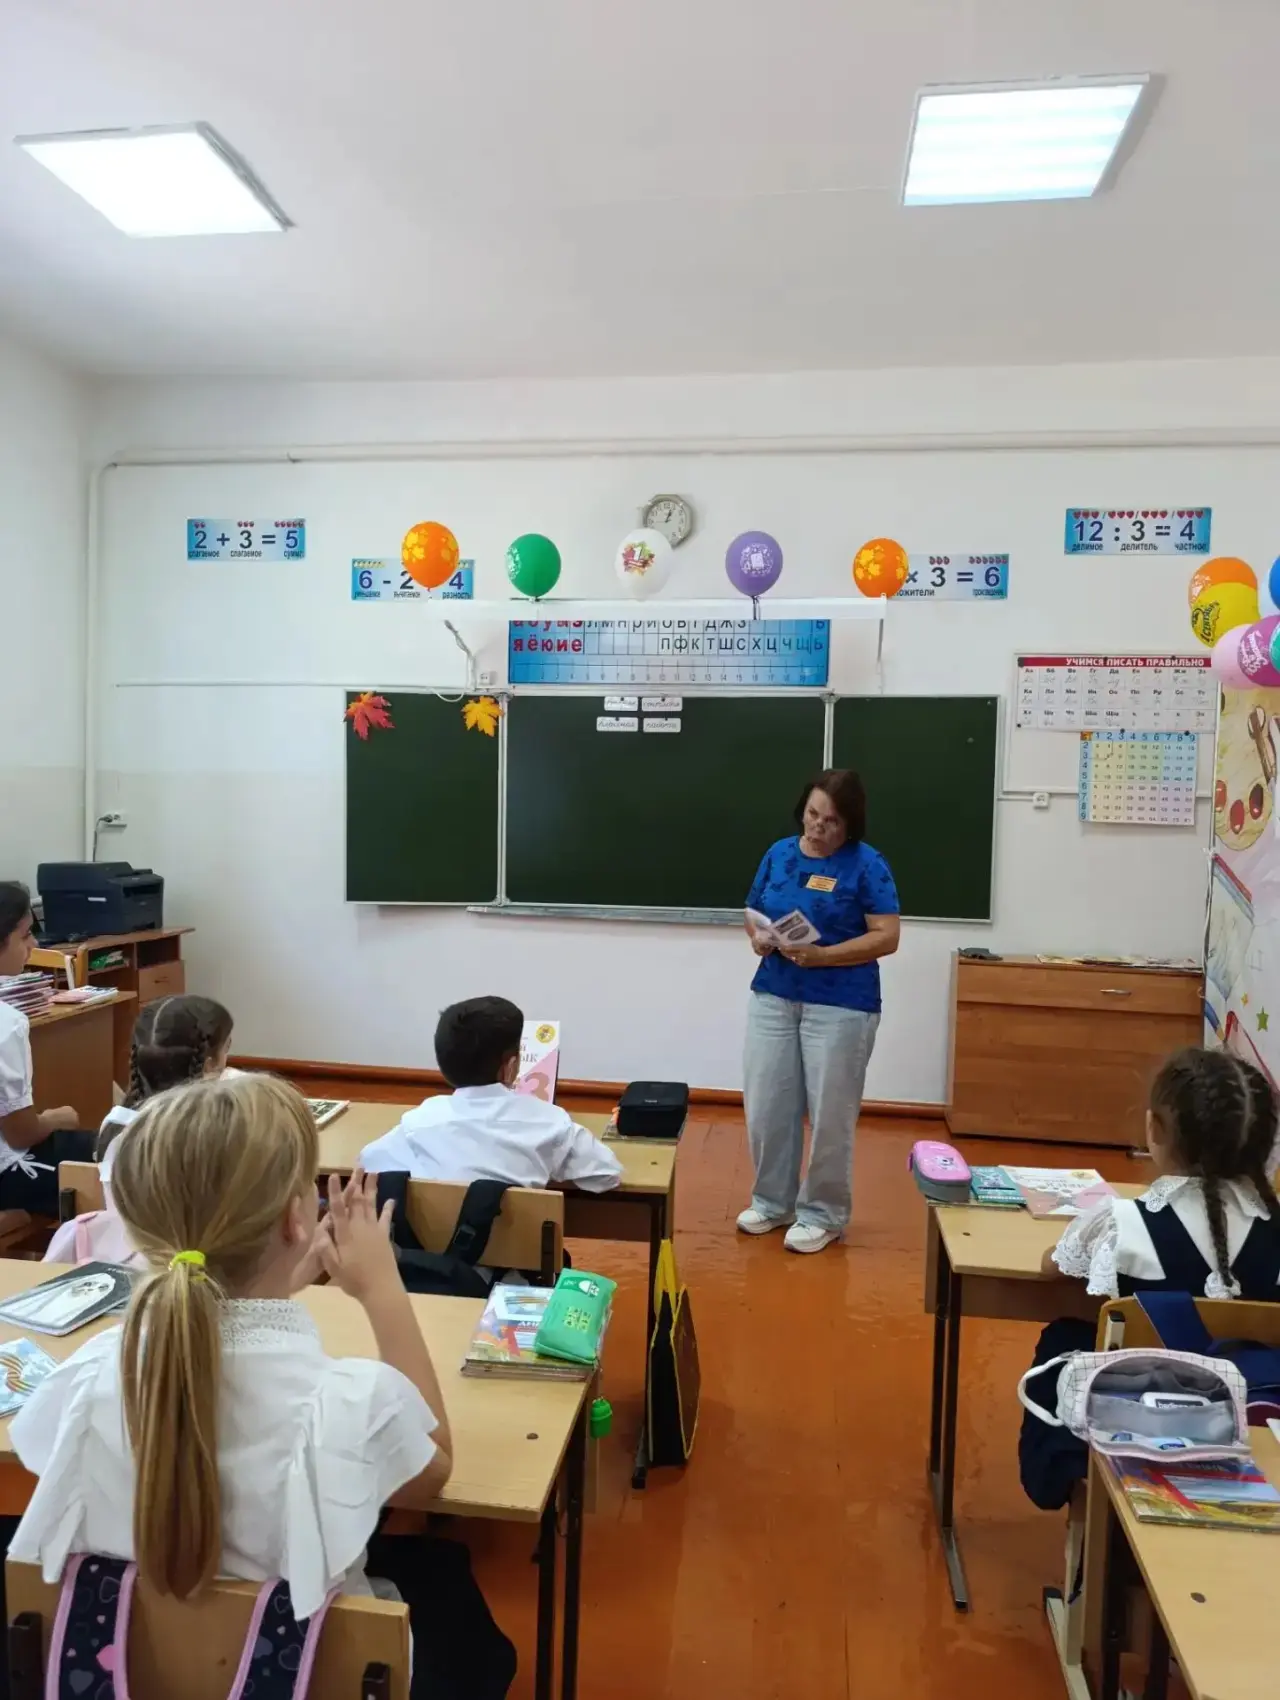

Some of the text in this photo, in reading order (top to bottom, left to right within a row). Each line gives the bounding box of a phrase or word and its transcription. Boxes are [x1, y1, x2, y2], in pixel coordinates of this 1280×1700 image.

[195, 530, 207, 548] 2
[239, 530, 252, 549] 3
[286, 530, 298, 548] 5
[1075, 521, 1103, 541] 12
[1131, 520, 1145, 541] 3
[1180, 520, 1195, 540] 4
[1072, 543, 1103, 551] делимое
[1120, 543, 1158, 552] делитель
[359, 570, 372, 589] 6
[400, 570, 414, 589] 2
[449, 572, 464, 590] 4
[930, 567, 946, 587] 3
[985, 567, 1000, 587] 6
